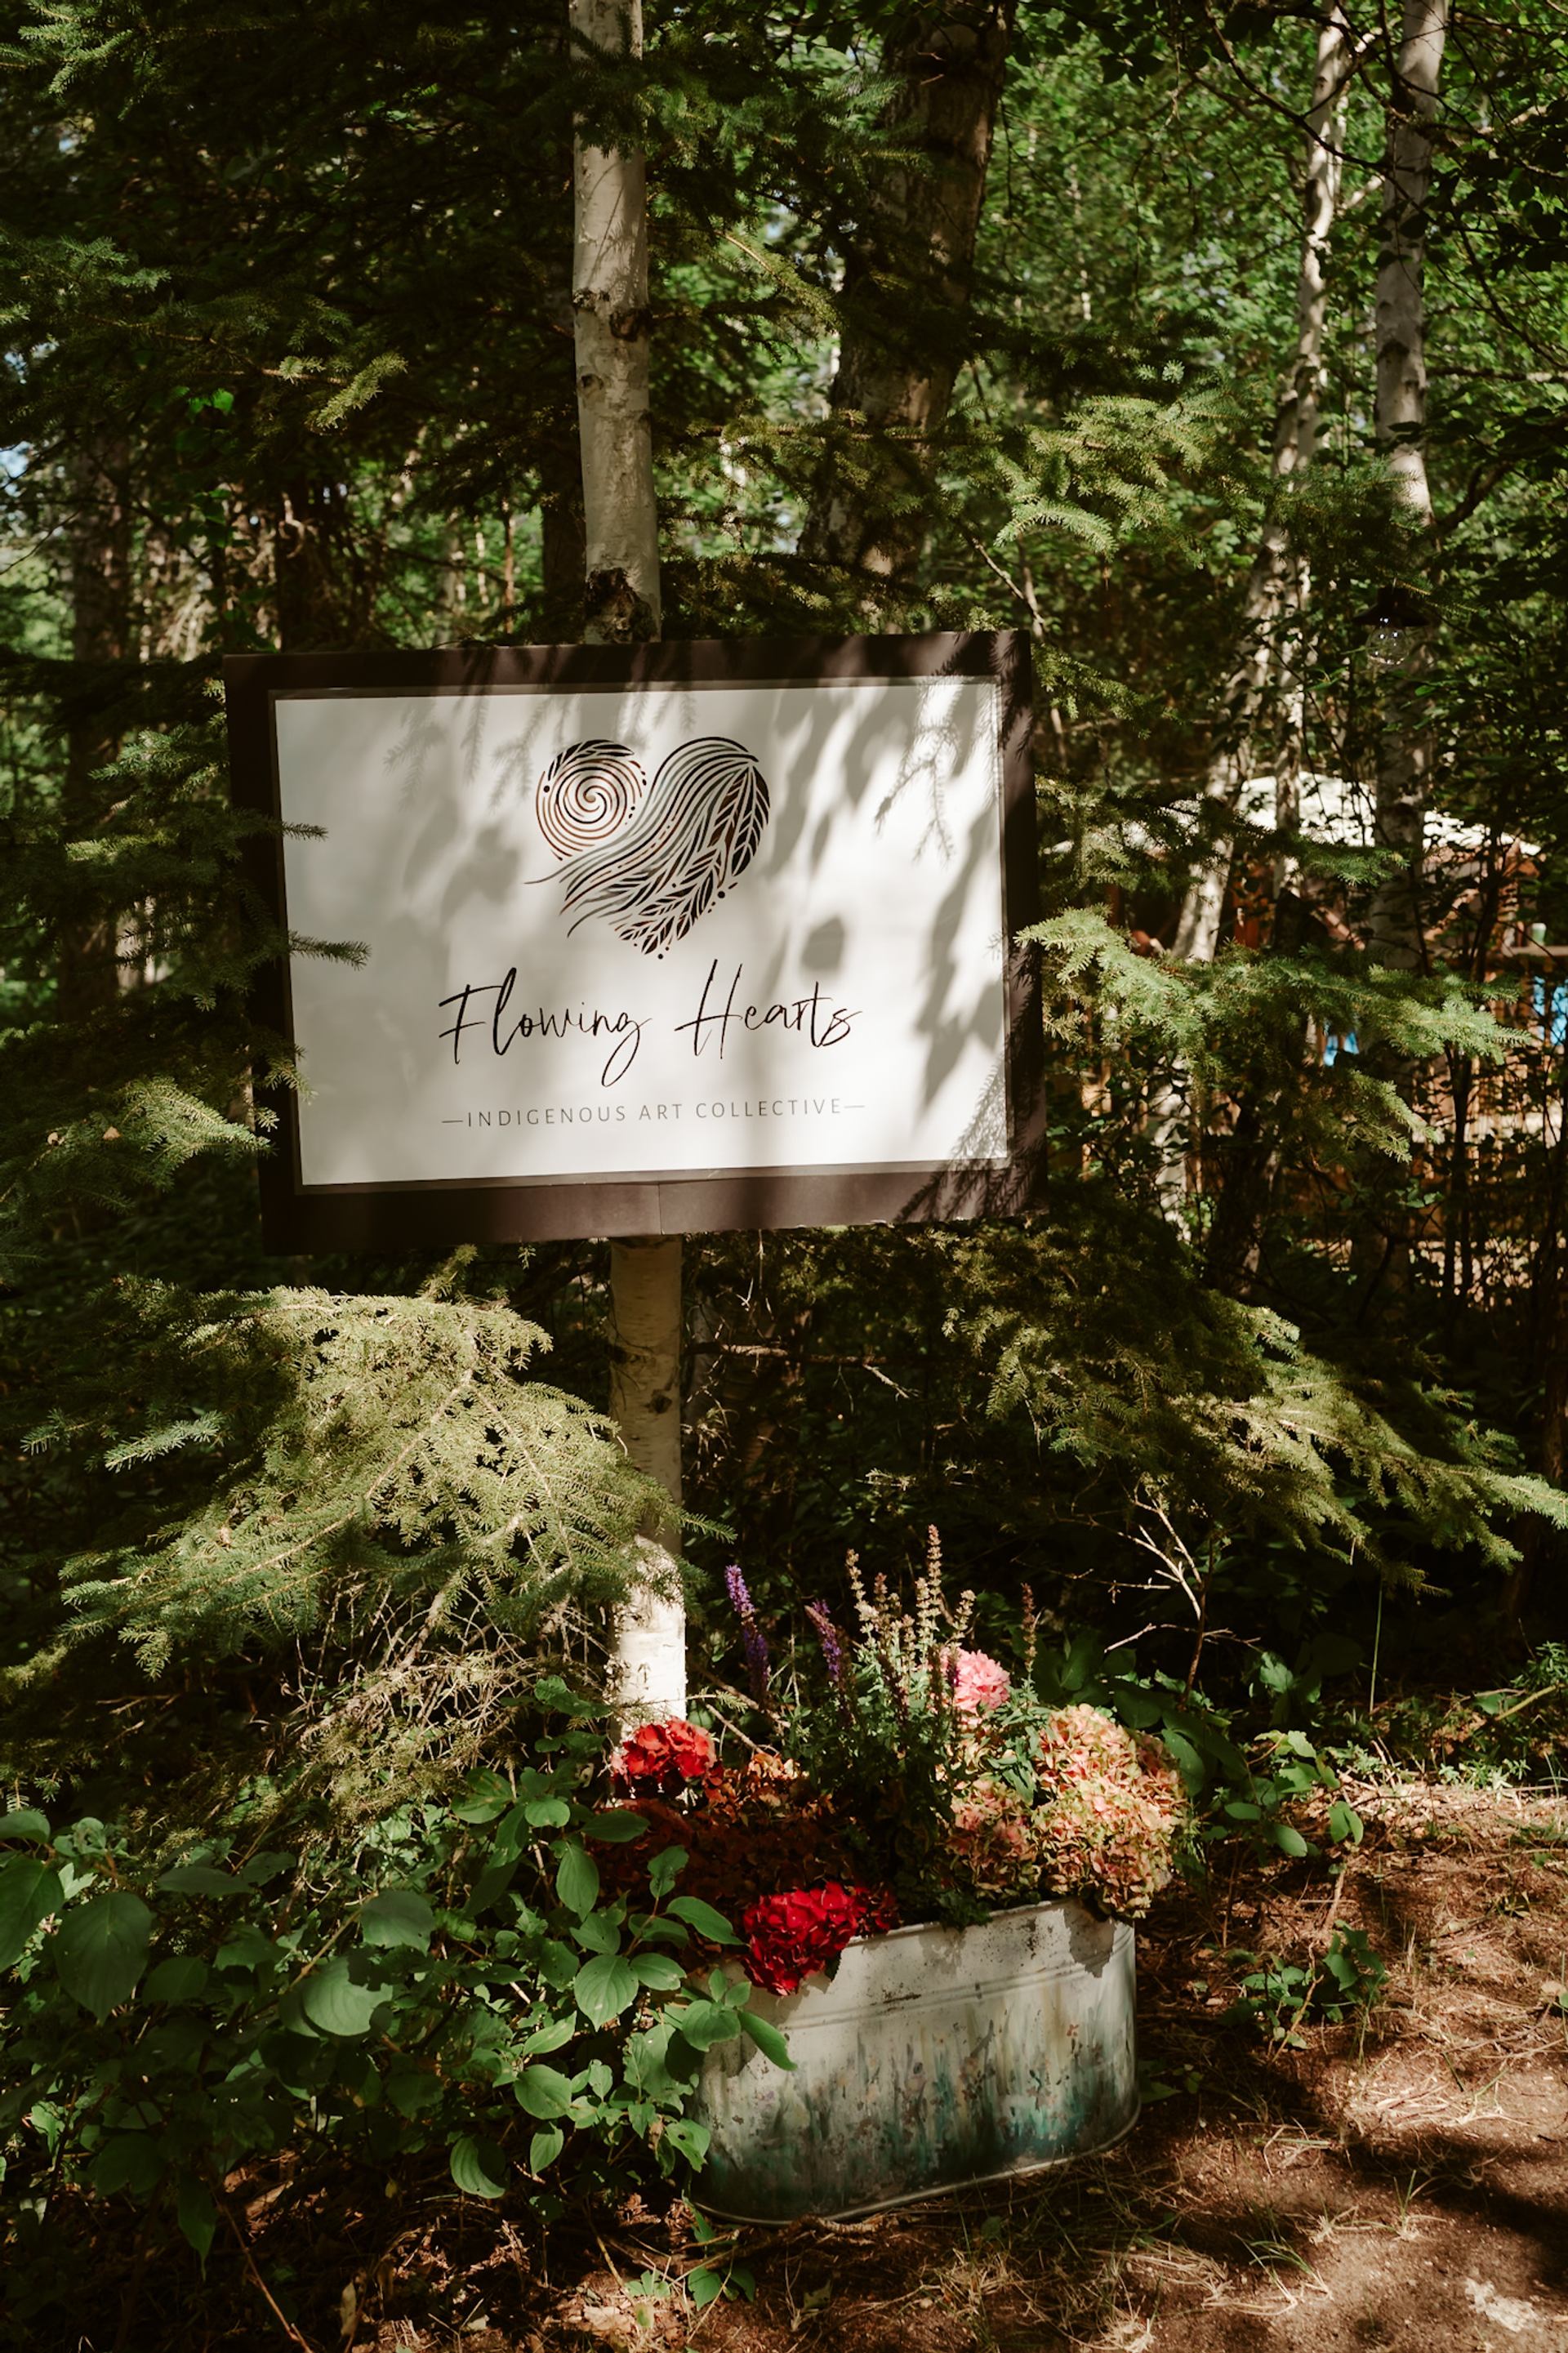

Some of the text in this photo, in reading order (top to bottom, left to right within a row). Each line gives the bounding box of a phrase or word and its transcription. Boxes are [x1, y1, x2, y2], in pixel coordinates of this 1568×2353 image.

[439, 959, 863, 1087] Flowing Hearts
[639, 1103, 683, 1121] ART
